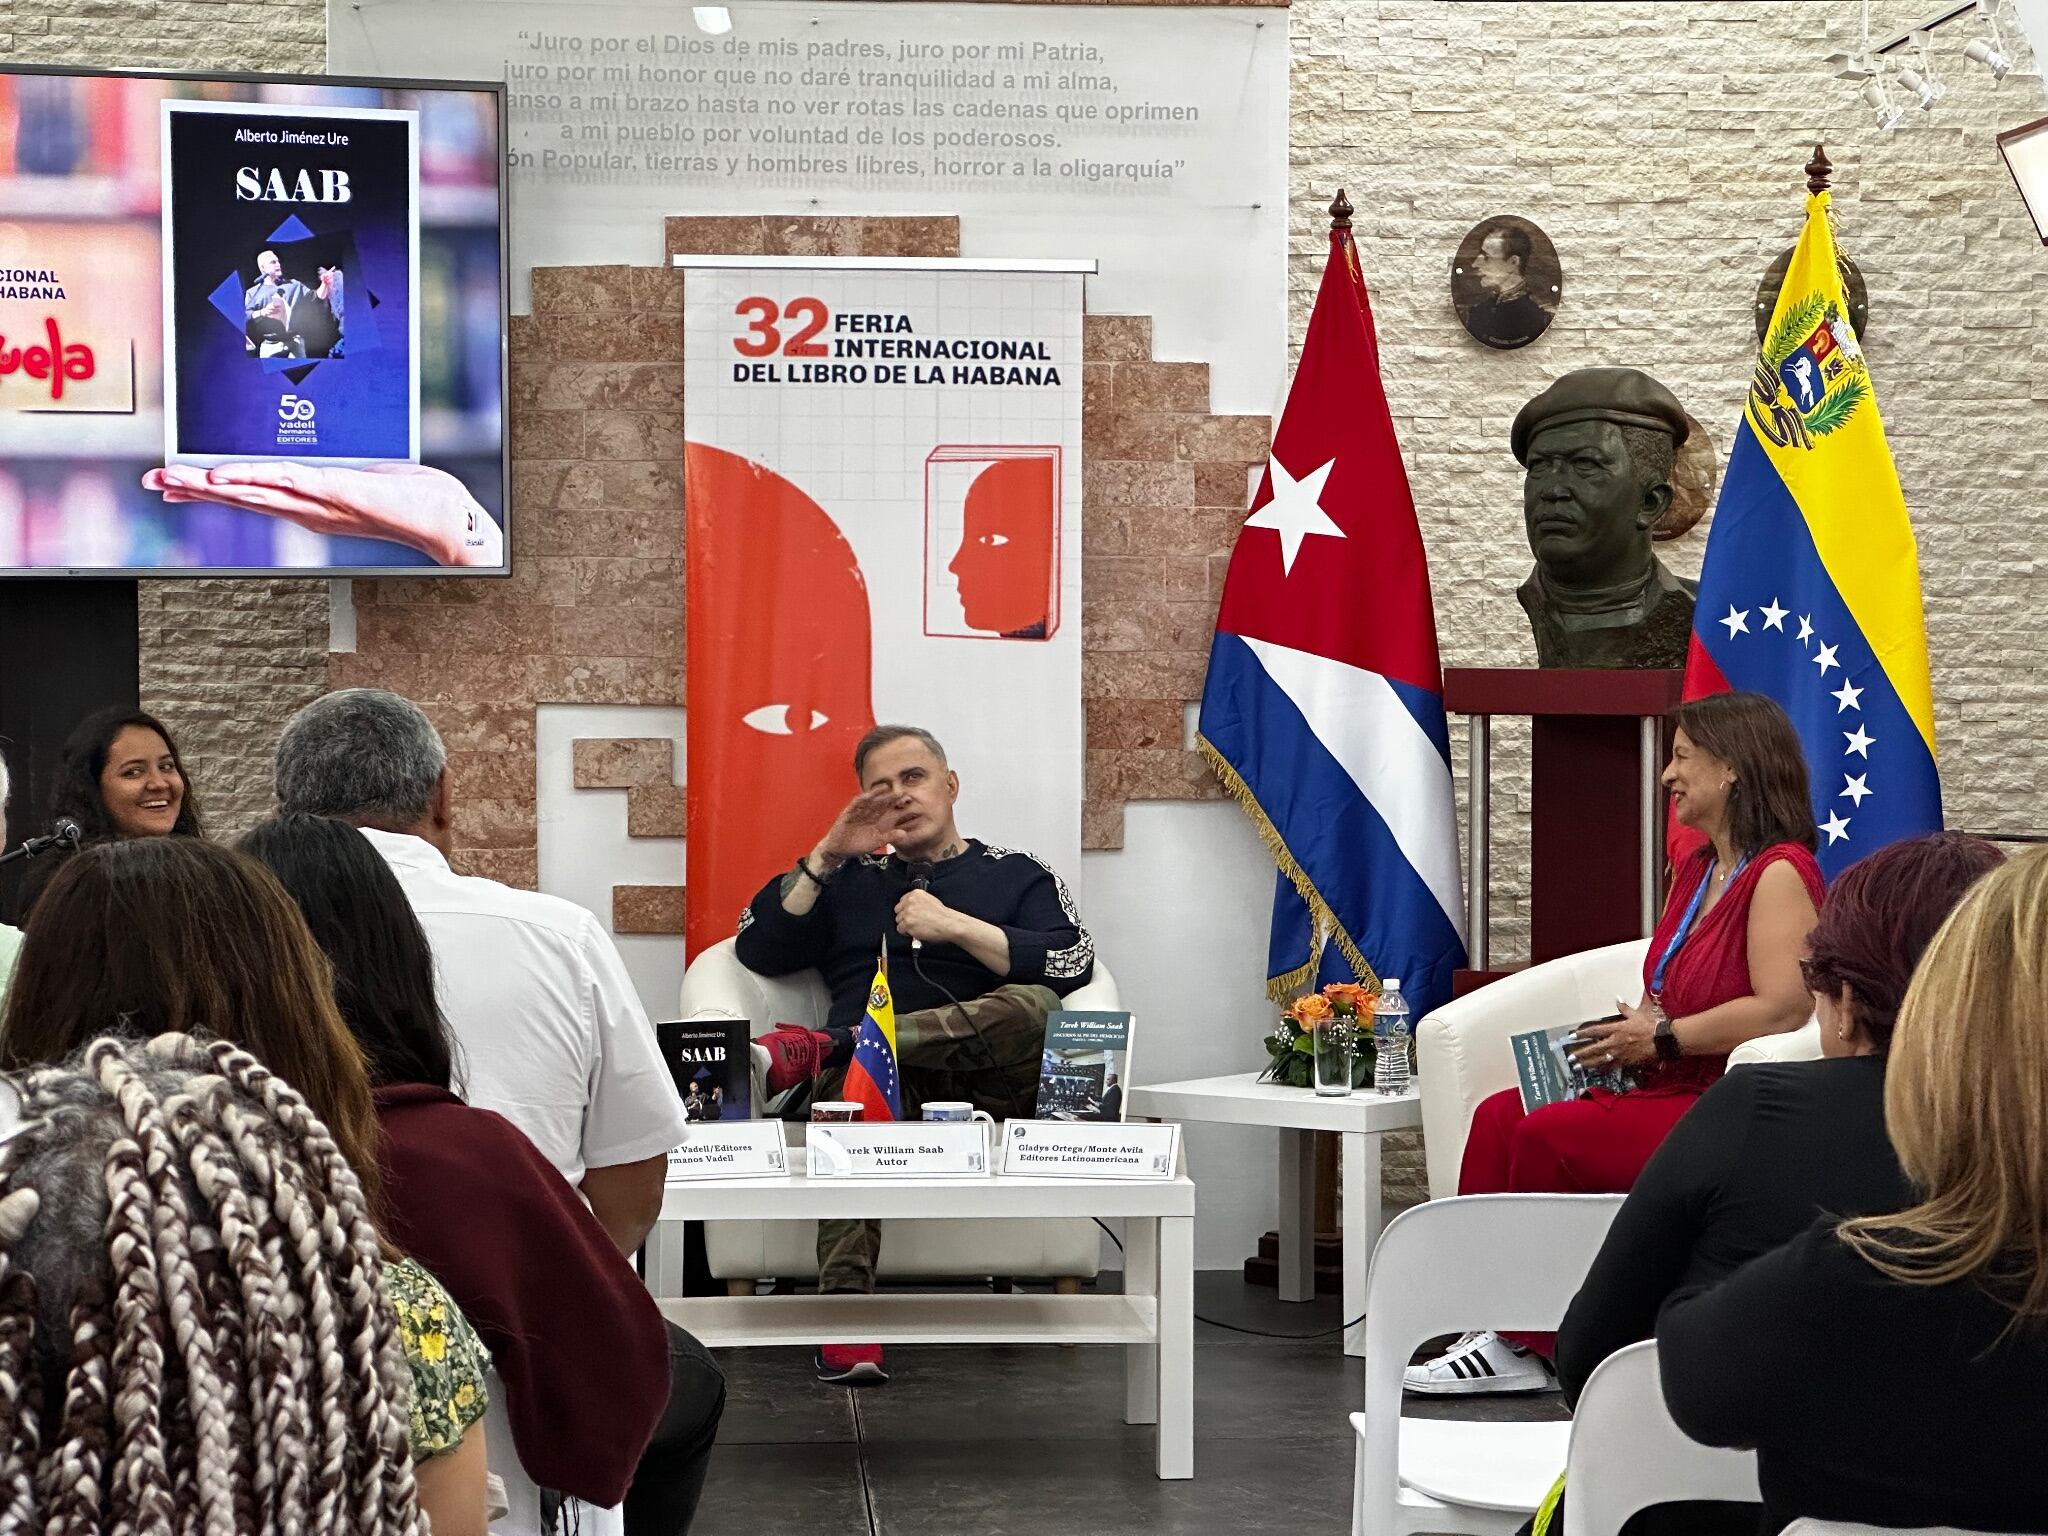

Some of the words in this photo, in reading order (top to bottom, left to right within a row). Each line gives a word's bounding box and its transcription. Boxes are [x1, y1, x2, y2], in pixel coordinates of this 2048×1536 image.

[590, 37, 630, 56] por
[636, 34, 655, 53] el
[664, 35, 714, 54] Dios
[723, 36, 750, 55] de
[758, 37, 799, 56] mis
[807, 39, 892, 61] padres,
[898, 40, 944, 62] juro
[952, 44, 990, 63] por
[998, 42, 1024, 60] mi
[1032, 42, 1104, 64] Patria,
[504, 60, 548, 80] juro
[557, 65, 596, 84] por
[604, 64, 630, 82] mi
[639, 64, 707, 83] honor
[714, 69, 756, 88] que
[764, 70, 793, 85] no
[800, 67, 850, 86] daré
[858, 68, 995, 92] tranquilidad
[1003, 74, 1015, 89] a
[1023, 71, 1050, 89] mi
[1058, 72, 1118, 93] alma,
[569, 95, 581, 109] a
[590, 92, 616, 111] mi
[625, 93, 689, 112] brazo
[698, 94, 759, 113] hasta
[768, 99, 796, 114] no
[804, 100, 840, 115] ver
[847, 97, 904, 116] rotas
[912, 98, 945, 117] las
[952, 99, 1048, 119] cadenas
[1056, 104, 1098, 122] que
[1105, 102, 1199, 123] oprimen
[234, 128, 278, 143] Alberto
[280, 130, 325, 145] Jiménez
[327, 132, 349, 146] Ure
[560, 124, 573, 139] a
[581, 121, 608, 140] mi
[617, 123, 695, 145] pueblo
[703, 128, 742, 146] por
[748, 124, 848, 145] voluntad
[856, 126, 884, 145] de
[892, 127, 925, 146] los
[933, 128, 1062, 150] poderosos.
[543, 149, 637, 172] Popular,
[645, 152, 718, 171] tierras
[726, 157, 738, 177] y
[747, 153, 848, 174] hombres
[856, 155, 925, 178] libres,
[934, 157, 1005, 176] horror
[1012, 161, 1025, 177] a
[1033, 158, 1051, 178] la
[236, 166, 352, 203] SAAB
[733, 296, 829, 358] 32
[834, 314, 914, 334] FERIA
[0, 317, 96, 400] uela
[834, 339, 1051, 361] INTERNACIONAL
[733, 363, 781, 384] DEL
[788, 364, 867, 384] LIBRO
[874, 365, 907, 385] DE
[914, 366, 946, 386] LA
[952, 366, 1061, 387] HABANA
[278, 394, 316, 421] 50
[279, 420, 316, 429] vadell
[1080, 1021, 1106, 1029] William
[1106, 1022, 1124, 1030] Saab
[681, 1046, 726, 1062] SAAB
[681, 1144, 752, 1153] Vadell/Editores
[705, 1154, 734, 1163] Vadell
[845, 1147, 870, 1155] arek
[873, 1146, 914, 1154] William
[918, 1146, 944, 1154] Saab
[1018, 1144, 1049, 1152] Gladys
[1120, 1146, 1143, 1154] Avila
[1020, 1154, 1058, 1162] Editores
[1062, 1154, 1139, 1164] Latinoamericana
[876, 1157, 908, 1166] Autor
